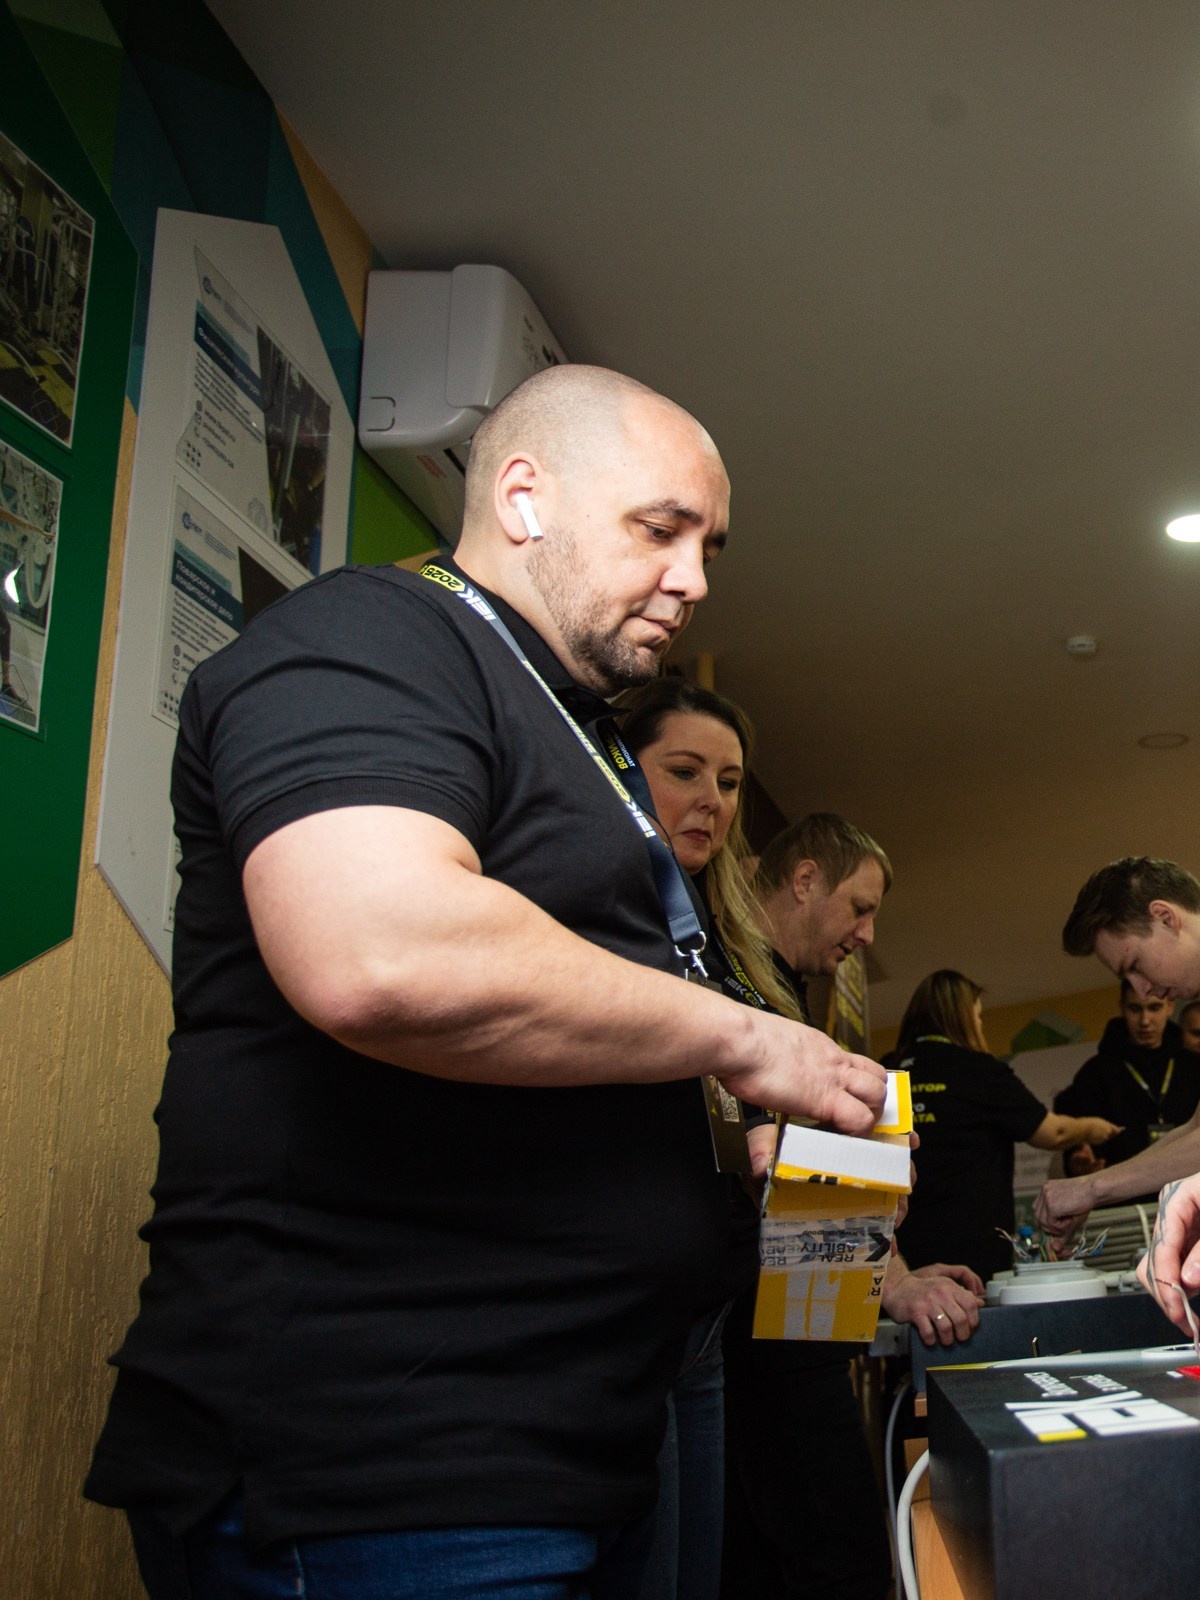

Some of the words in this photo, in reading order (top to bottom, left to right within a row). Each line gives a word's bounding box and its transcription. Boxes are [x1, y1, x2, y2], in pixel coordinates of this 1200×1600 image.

[424, 566, 461, 589] 2025
[607, 737, 629, 770] РИКОВ
[614, 733, 636, 767] ЕМПИОНАТ
[799, 1241, 856, 1254] ABILITY
[820, 1252, 855, 1263] REAL
